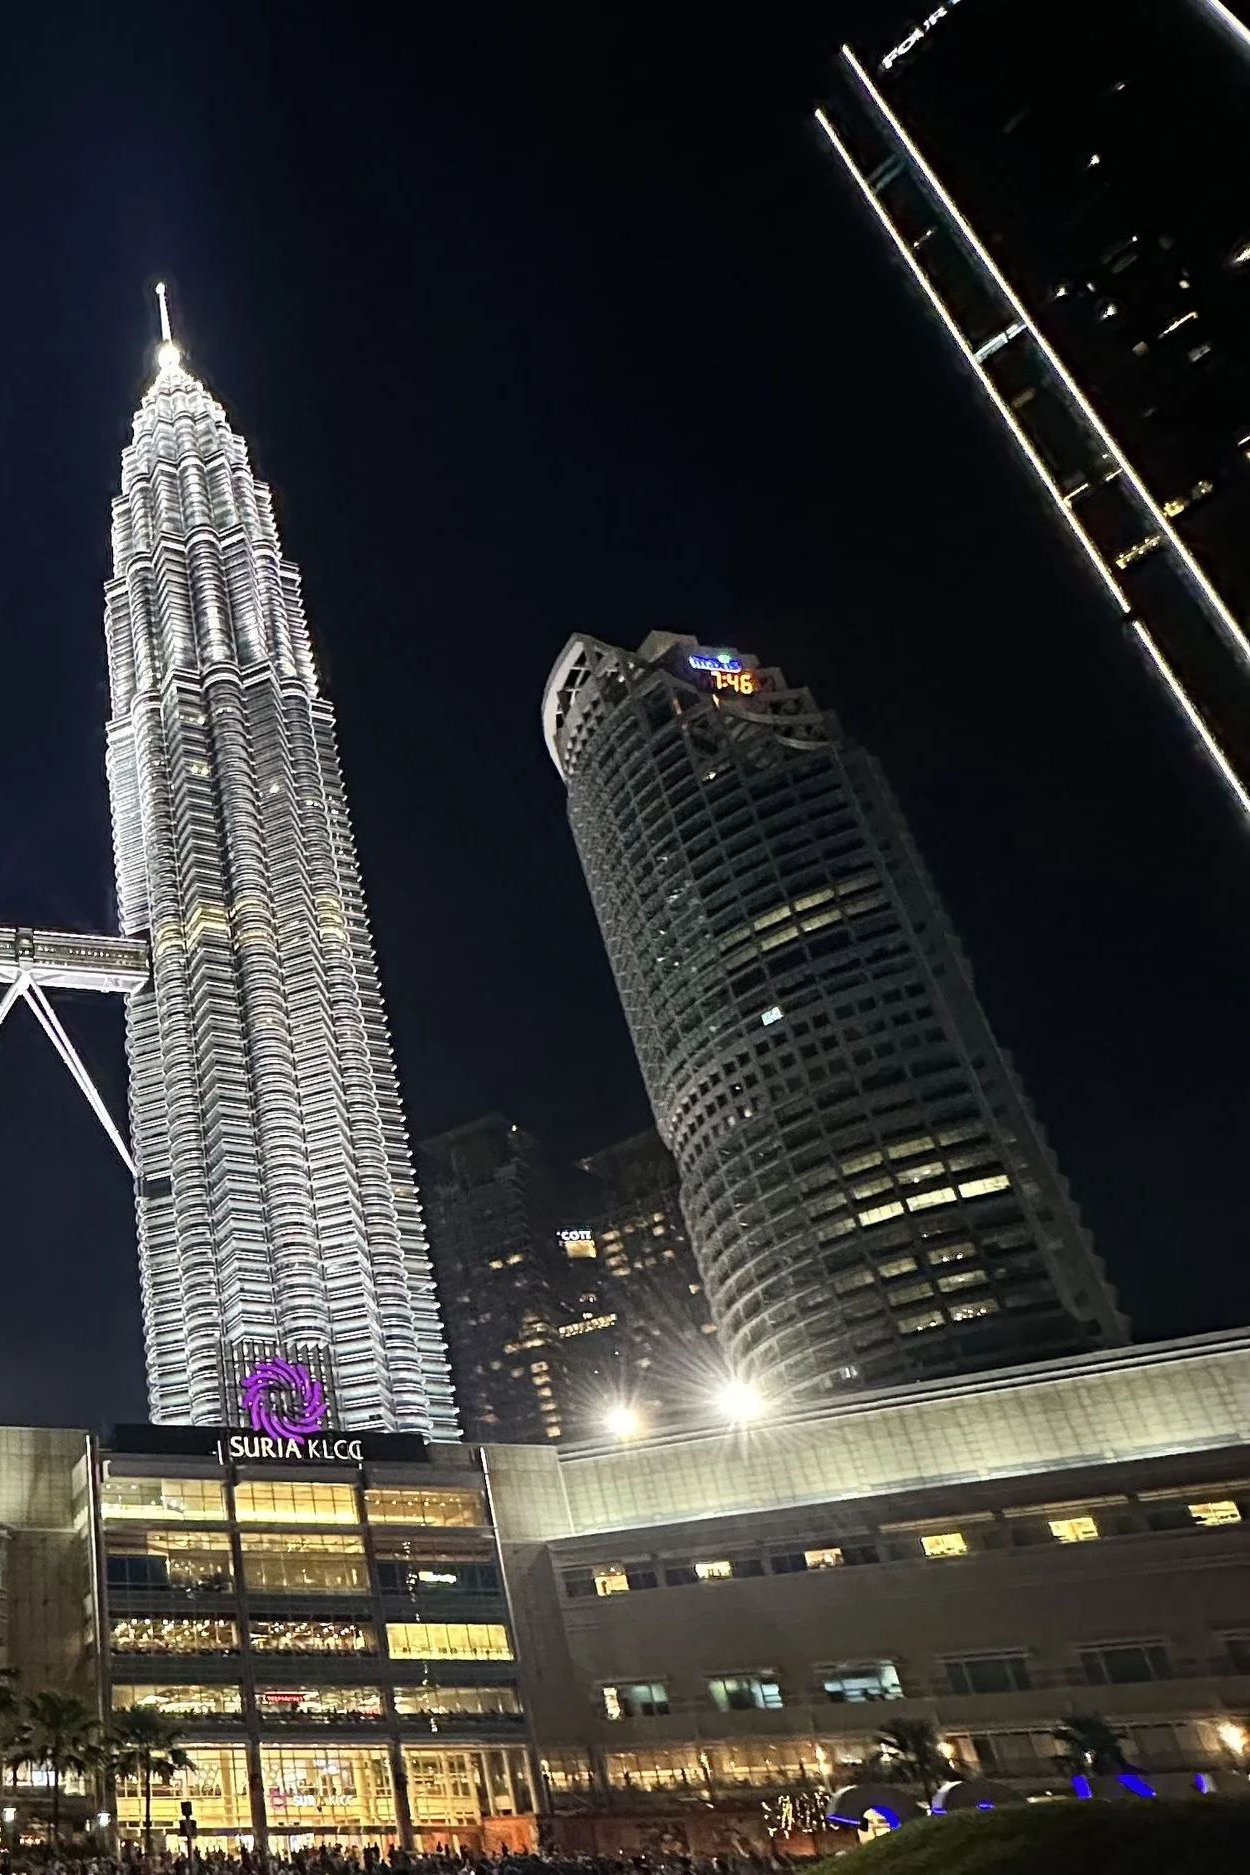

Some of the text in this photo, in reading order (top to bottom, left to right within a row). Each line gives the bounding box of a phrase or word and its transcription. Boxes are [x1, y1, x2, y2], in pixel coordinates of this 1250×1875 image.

[711, 670, 753, 694] 7:46
[230, 1436, 363, 1460] SURIA KLCC
